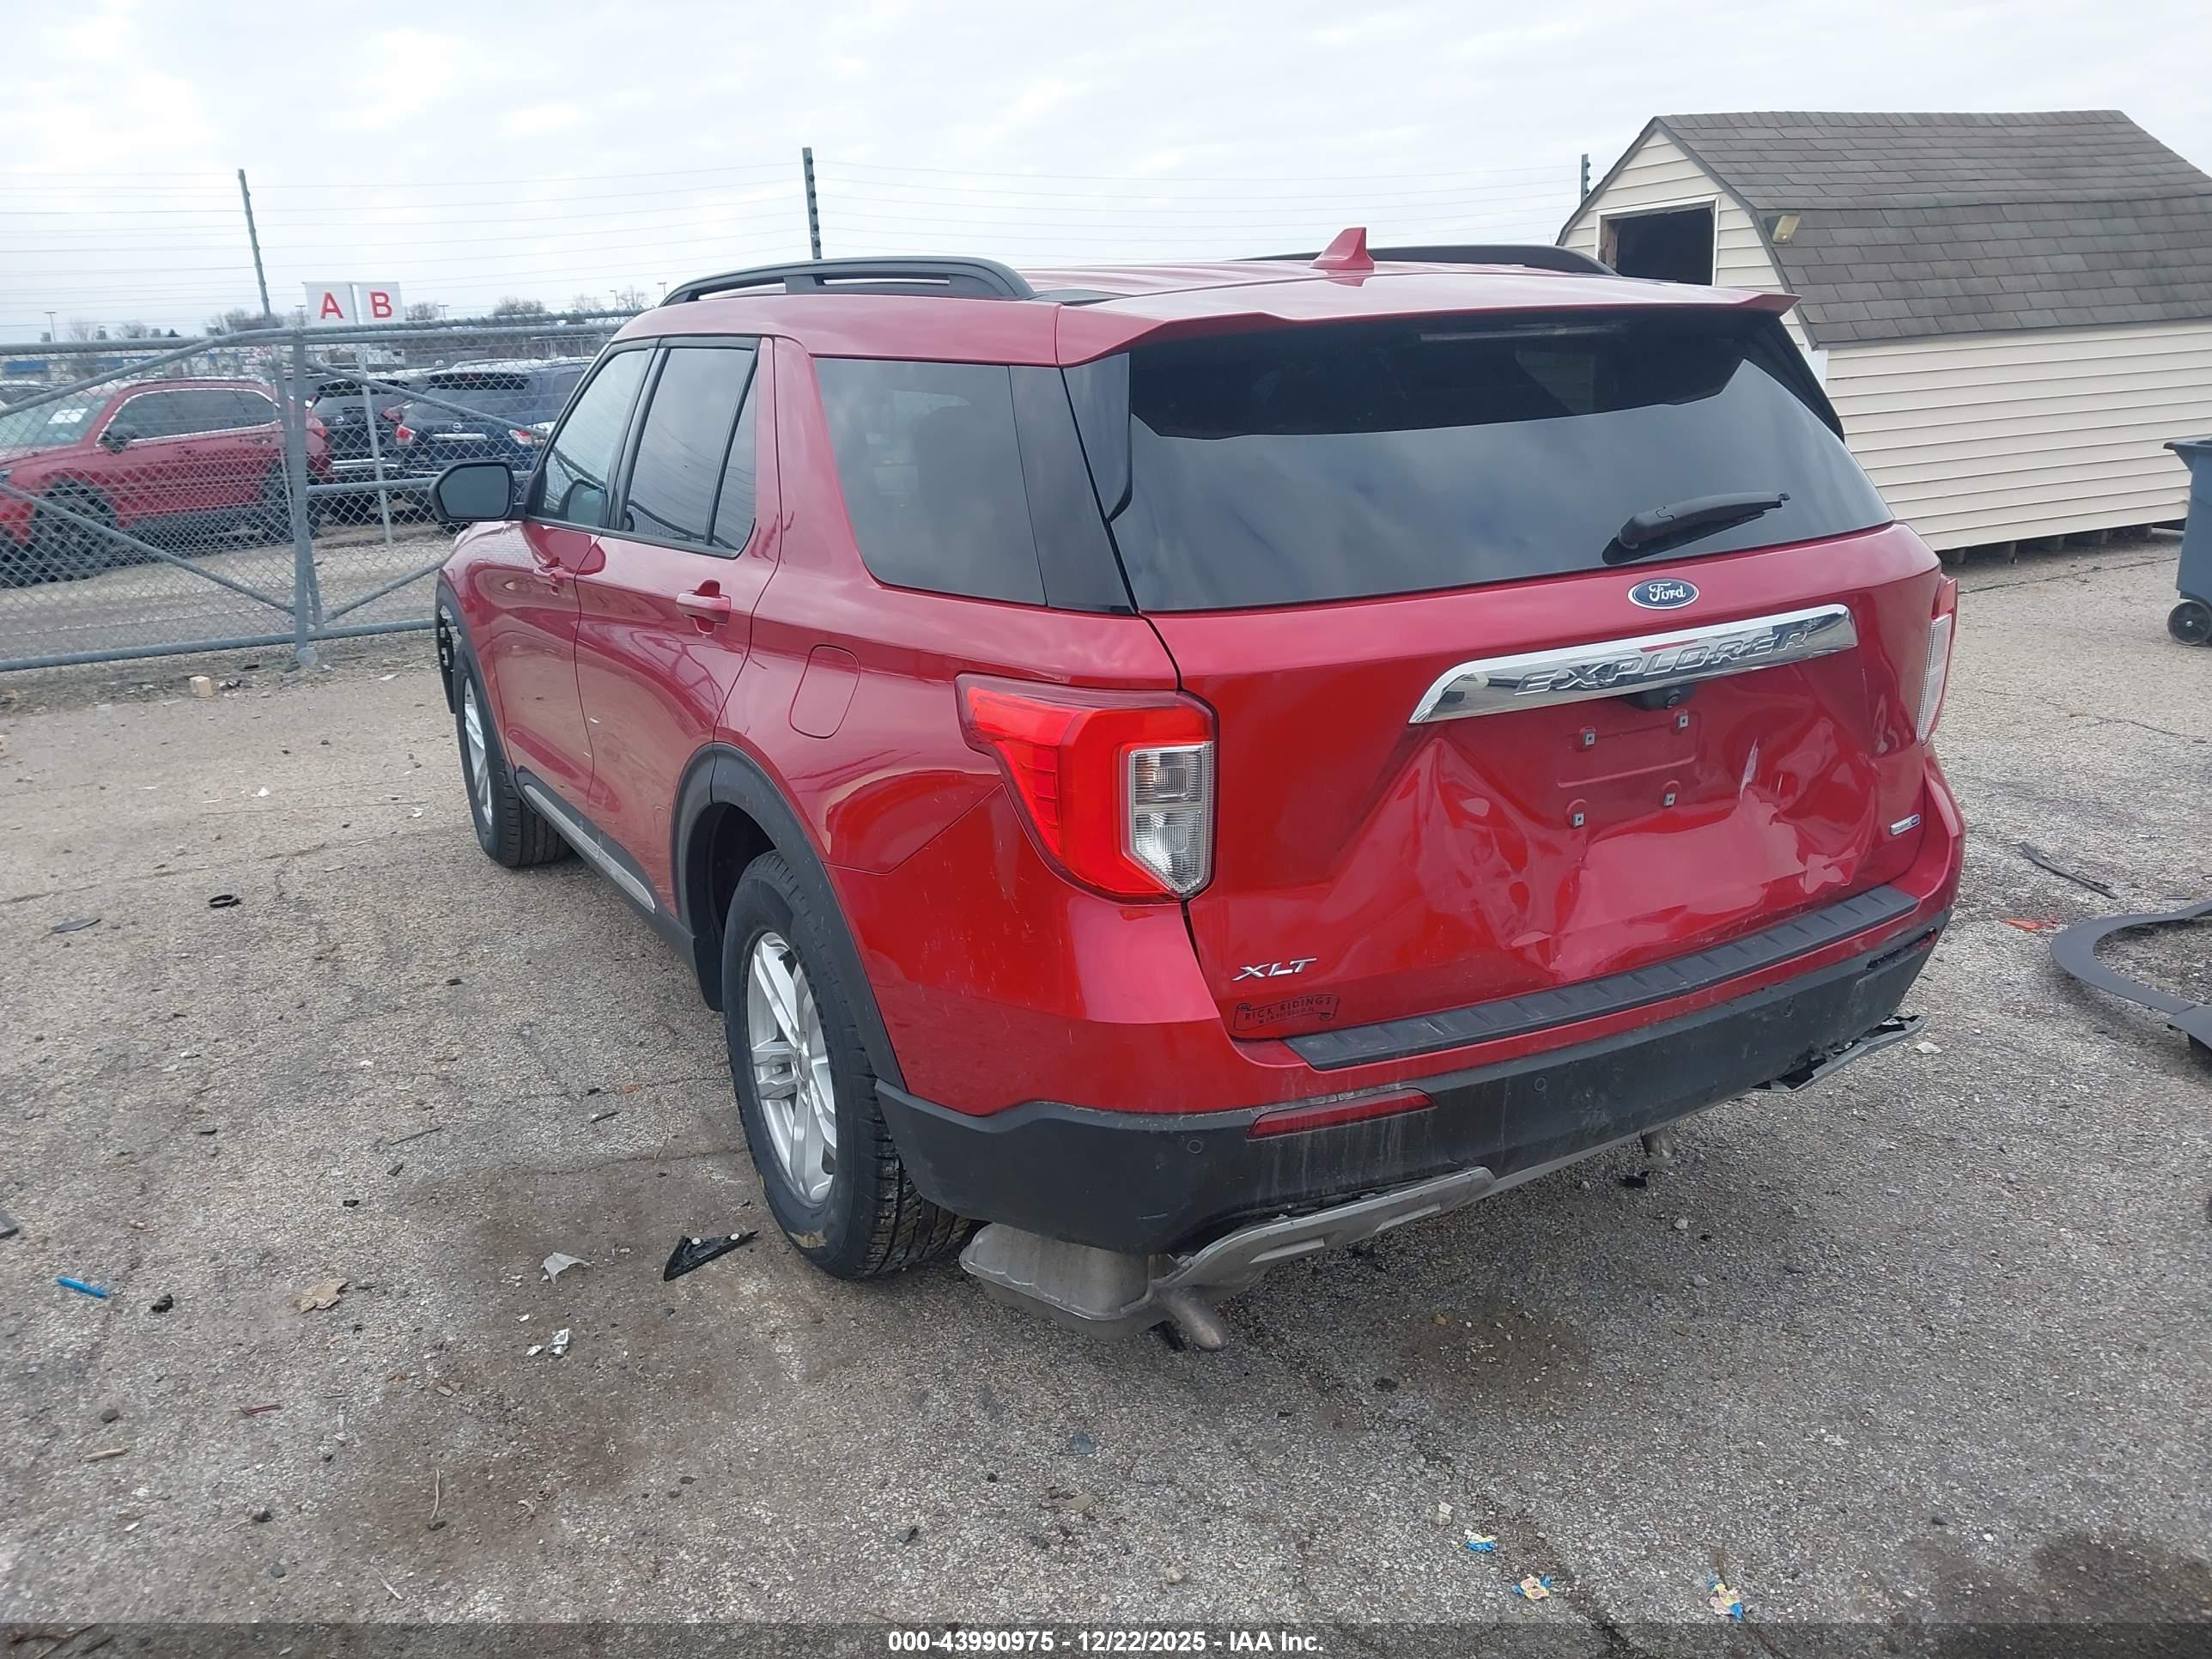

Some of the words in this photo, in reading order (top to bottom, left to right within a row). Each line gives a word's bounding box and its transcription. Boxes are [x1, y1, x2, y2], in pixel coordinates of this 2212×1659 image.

[320, 292, 344, 319] A
[370, 292, 392, 319] B
[1648, 583, 1686, 602] Ford
[1514, 630, 1809, 696] EXPLORER
[1231, 957, 1318, 981] XLT
[1245, 1006, 1273, 1021] RICK
